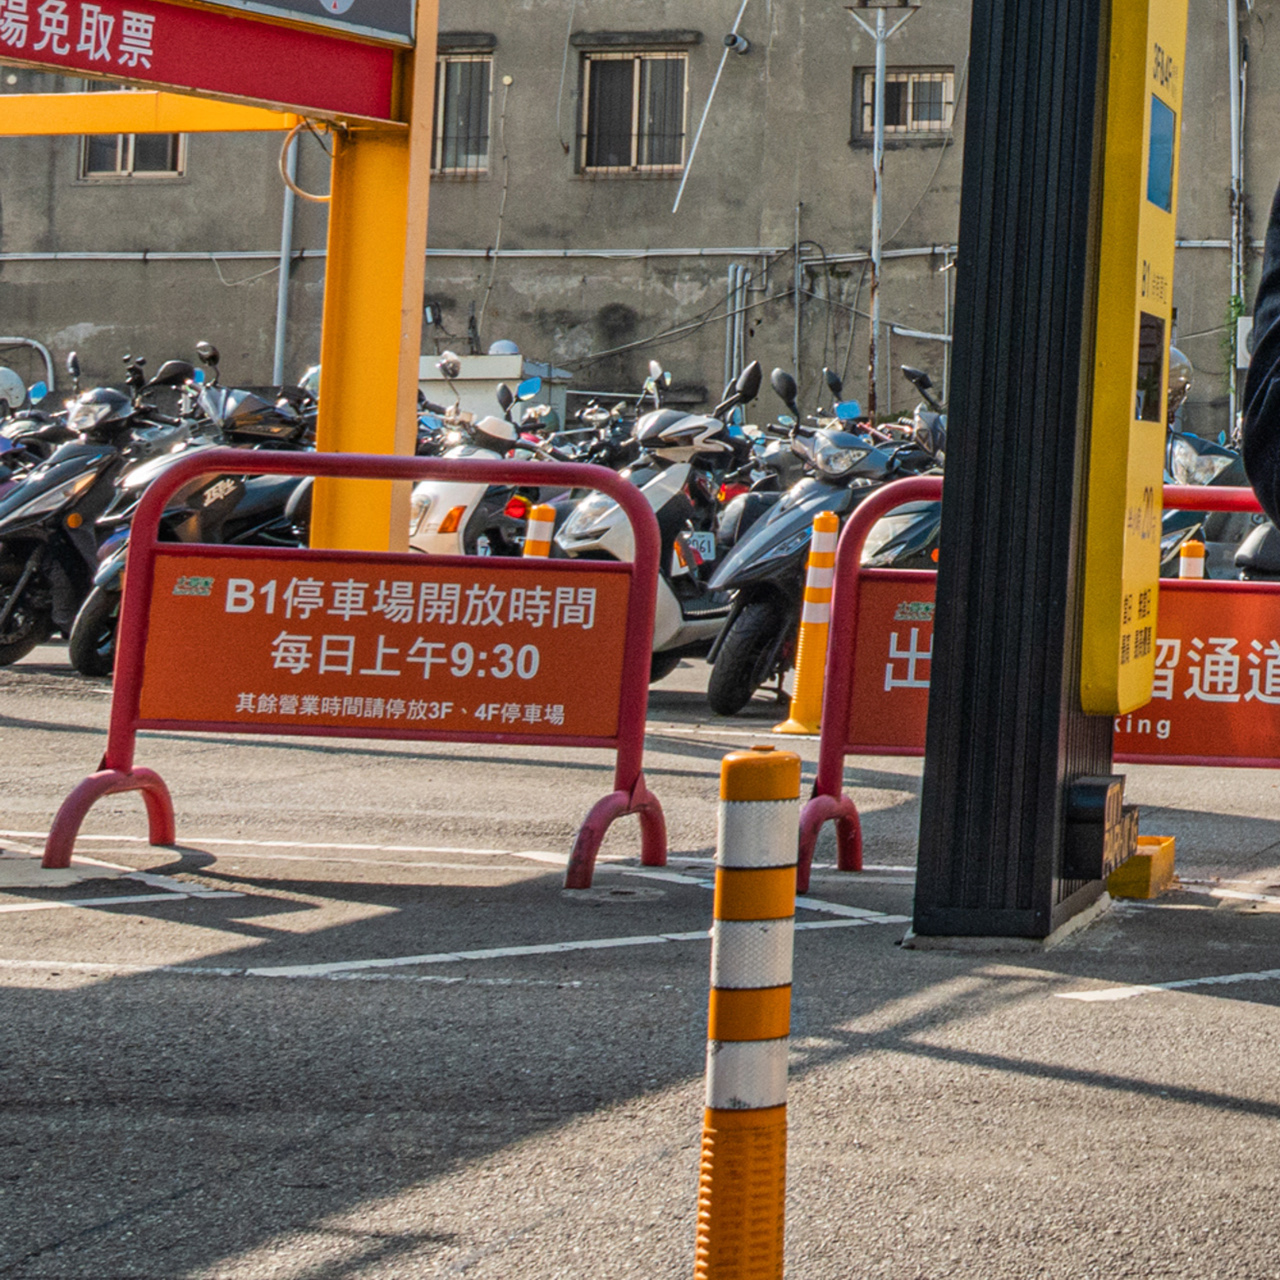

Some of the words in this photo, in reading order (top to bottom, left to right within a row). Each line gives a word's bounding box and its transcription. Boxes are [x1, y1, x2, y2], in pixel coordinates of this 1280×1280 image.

[225, 576, 598, 630] B1停車場開放時間
[270, 630, 540, 680] 每日上午9:30
[884, 627, 935, 692] 出
